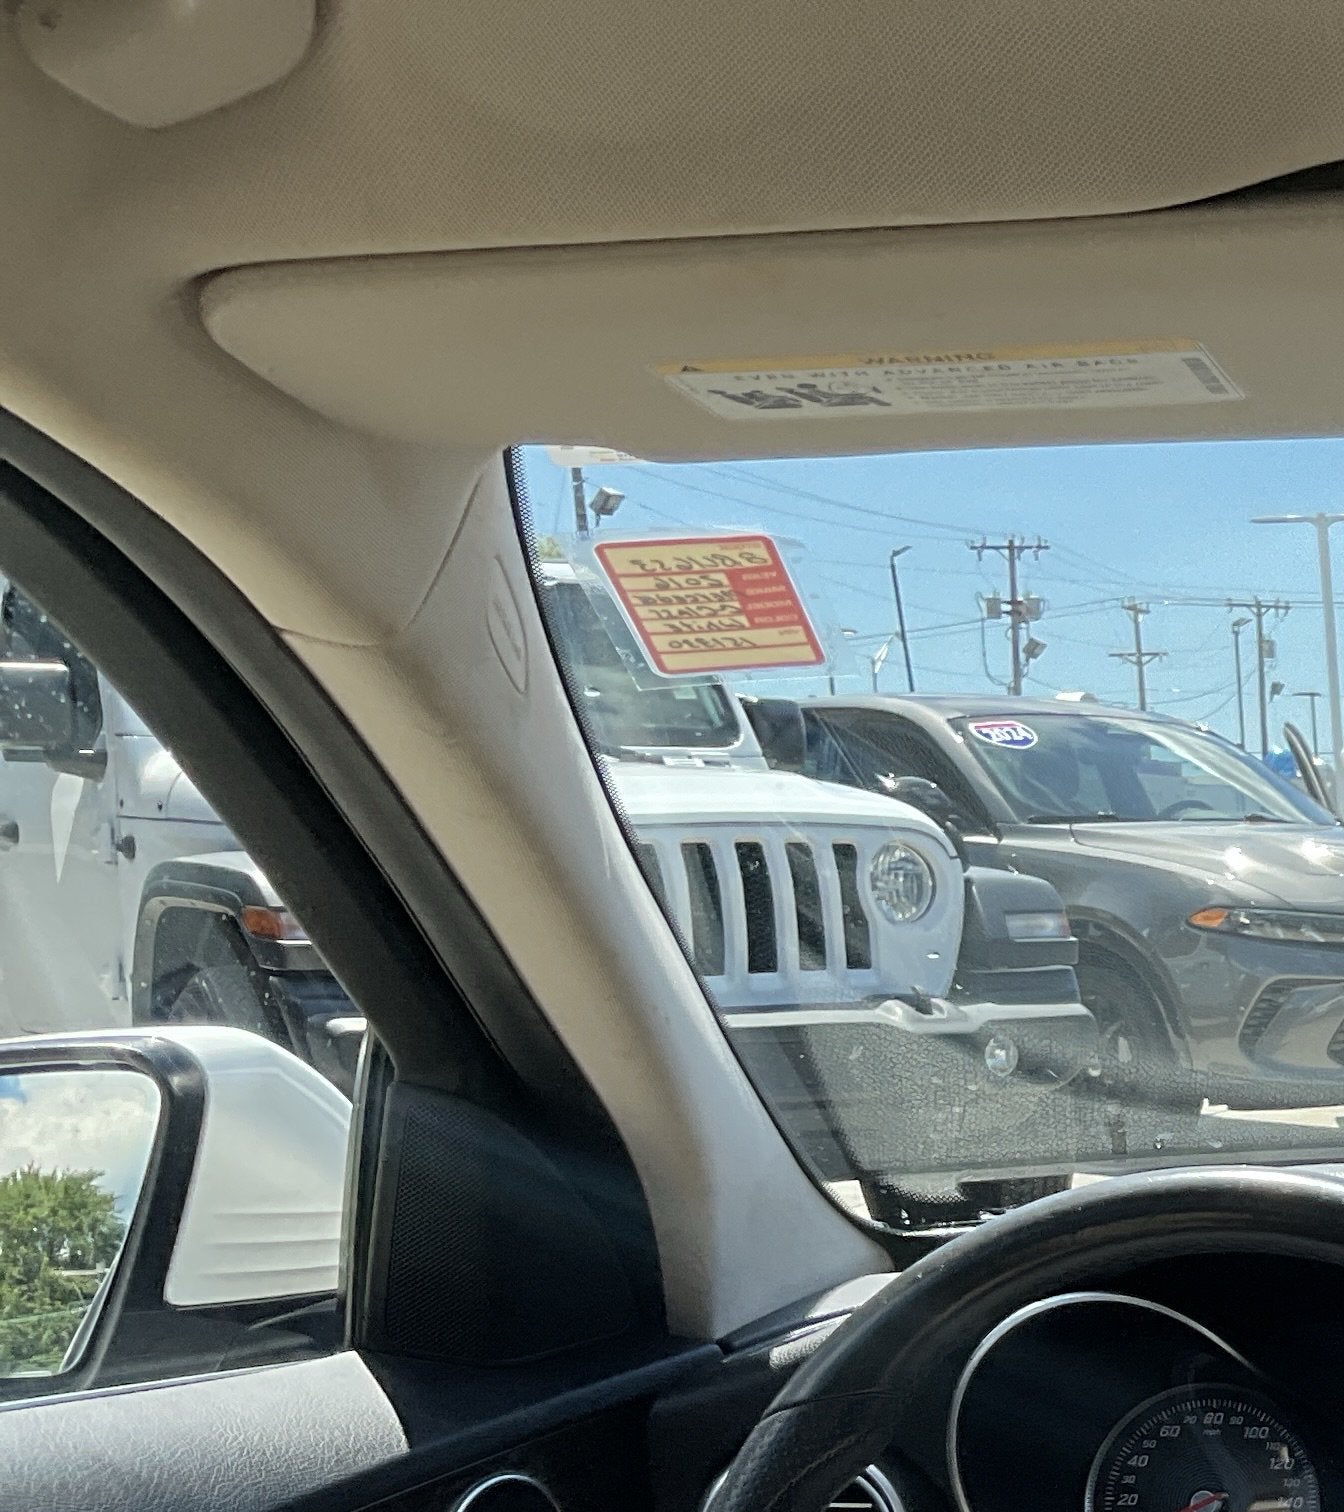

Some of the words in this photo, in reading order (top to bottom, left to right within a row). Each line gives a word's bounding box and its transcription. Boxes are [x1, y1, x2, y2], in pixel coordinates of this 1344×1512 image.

[1203, 1412, 1225, 1425] 80
[1159, 1425, 1181, 1438] 60
[1243, 1426, 1270, 1439] 100
[1127, 1455, 1149, 1468] 40
[1117, 1494, 1139, 1506] 20
